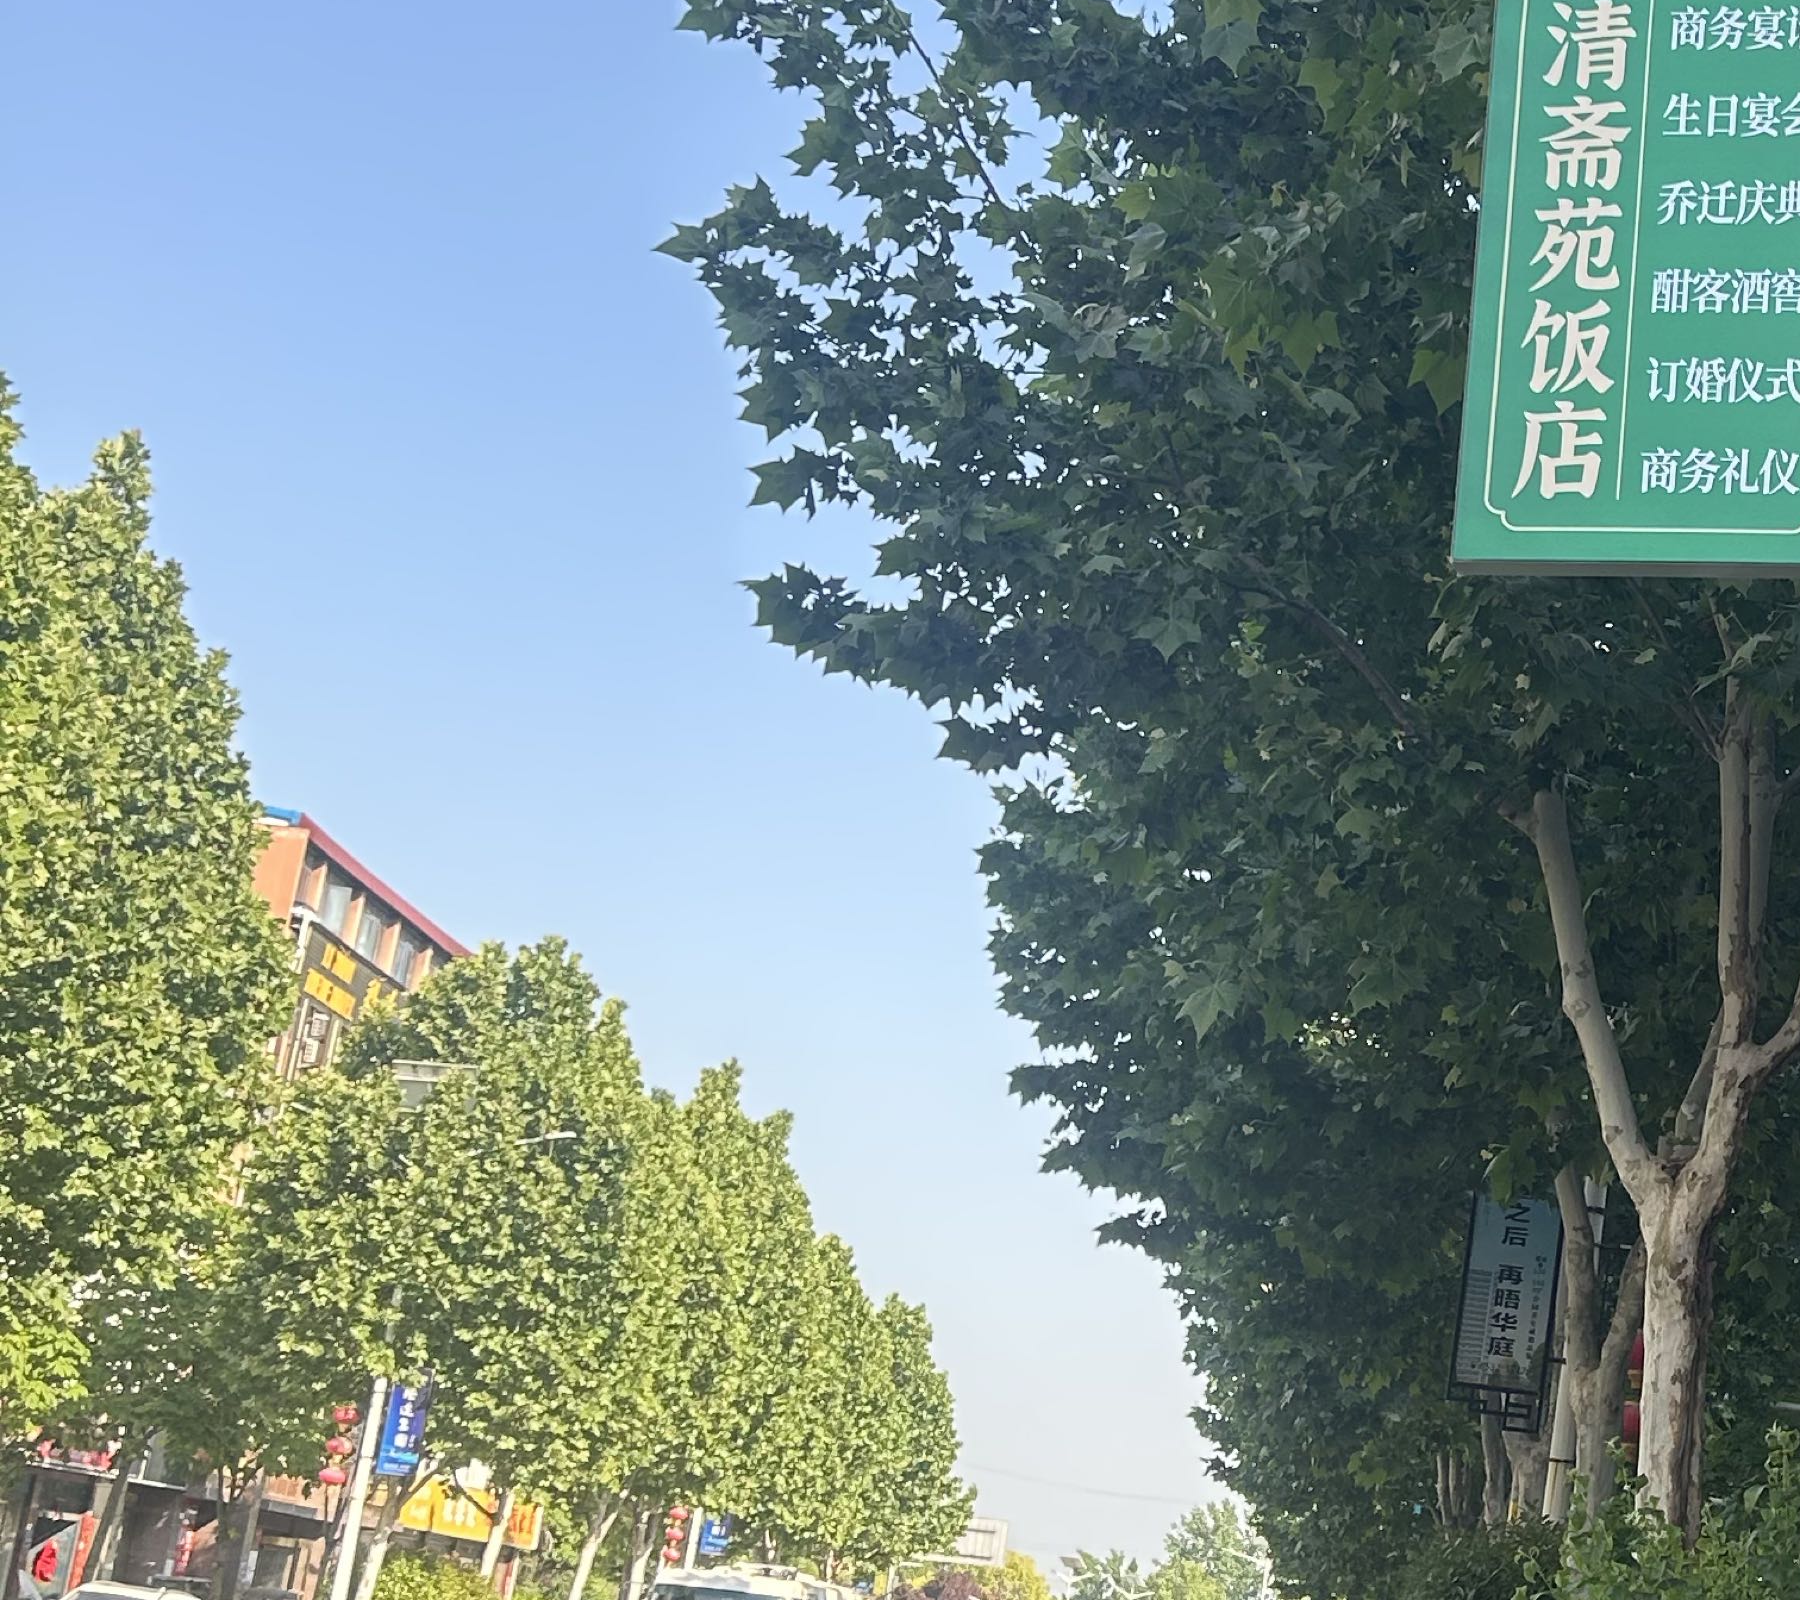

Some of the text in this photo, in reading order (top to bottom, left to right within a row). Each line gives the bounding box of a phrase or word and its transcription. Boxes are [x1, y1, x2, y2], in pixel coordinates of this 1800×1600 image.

[1640, 446, 1800, 497] 商务礼仪
[1487, 1264, 1525, 1358] 再晤华庭
